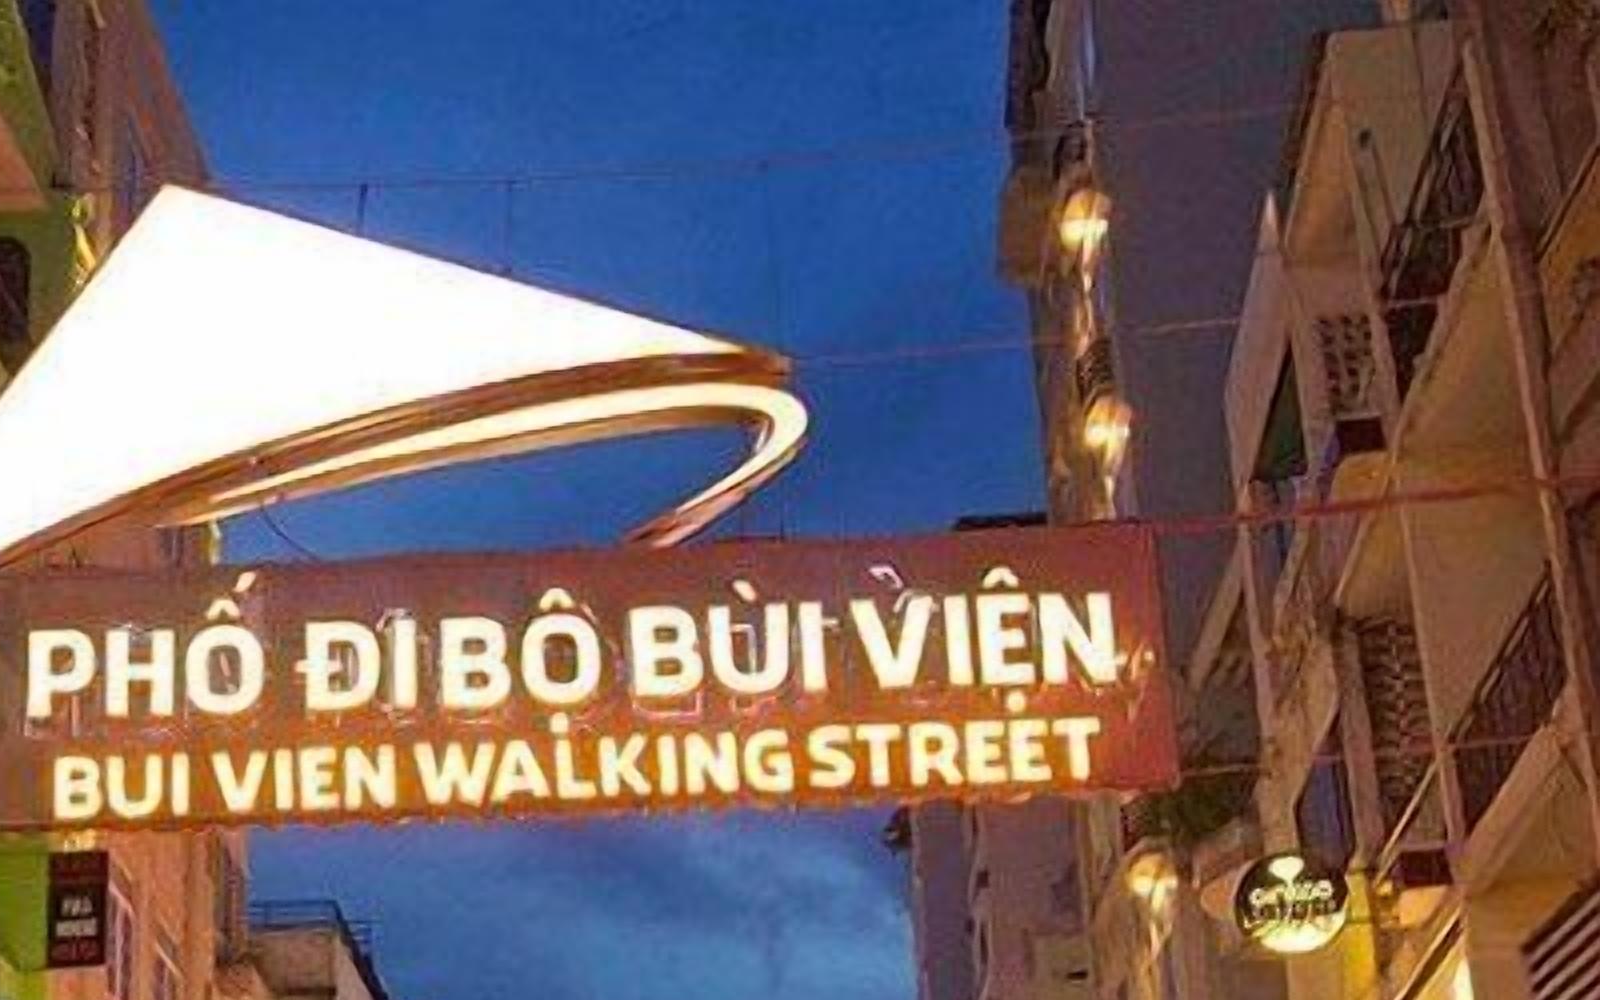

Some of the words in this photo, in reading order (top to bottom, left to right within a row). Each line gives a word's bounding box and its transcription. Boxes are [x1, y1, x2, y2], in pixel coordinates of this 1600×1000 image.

[26, 571, 265, 716] PHỐ
[295, 609, 418, 712] ĐI
[628, 581, 828, 698] BÙI
[53, 752, 190, 820] BUI
[212, 743, 397, 814] VIEN
[414, 728, 795, 807] WALKING
[807, 716, 1102, 788] STREET
